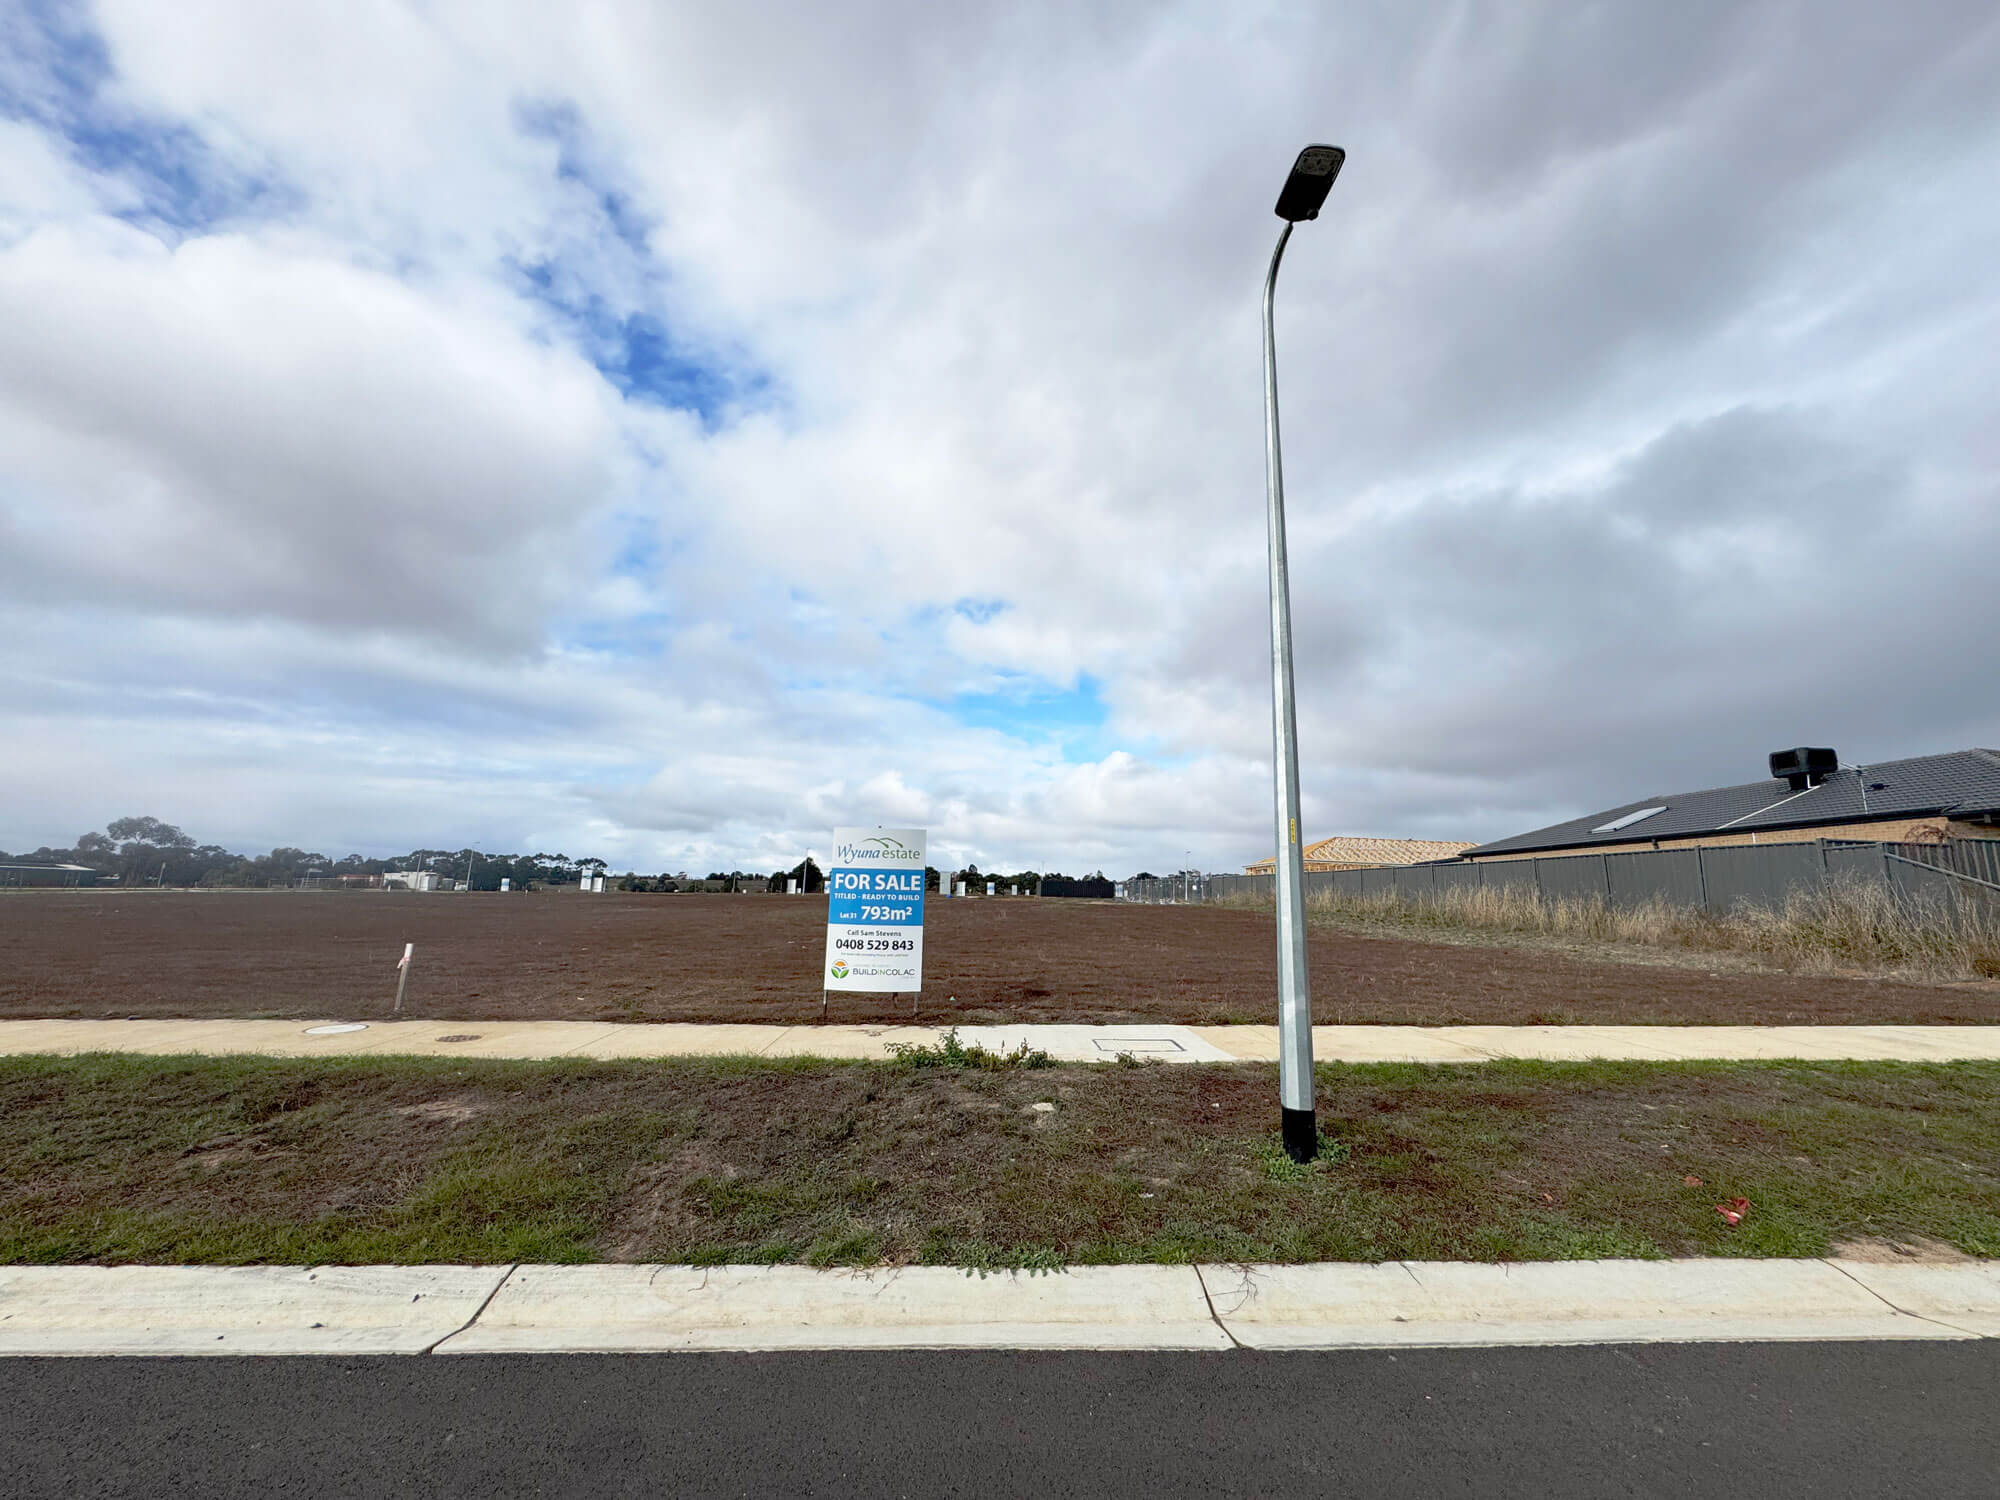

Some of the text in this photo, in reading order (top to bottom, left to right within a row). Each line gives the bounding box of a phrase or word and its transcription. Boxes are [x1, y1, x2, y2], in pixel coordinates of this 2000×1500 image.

[838, 843, 921, 864] Wyuna estate
[834, 873, 921, 890] FOR SALE
[834, 892, 857, 900] TITLED
[860, 905, 913, 920] 793m²
[836, 938, 914, 951] 0408 529 843
